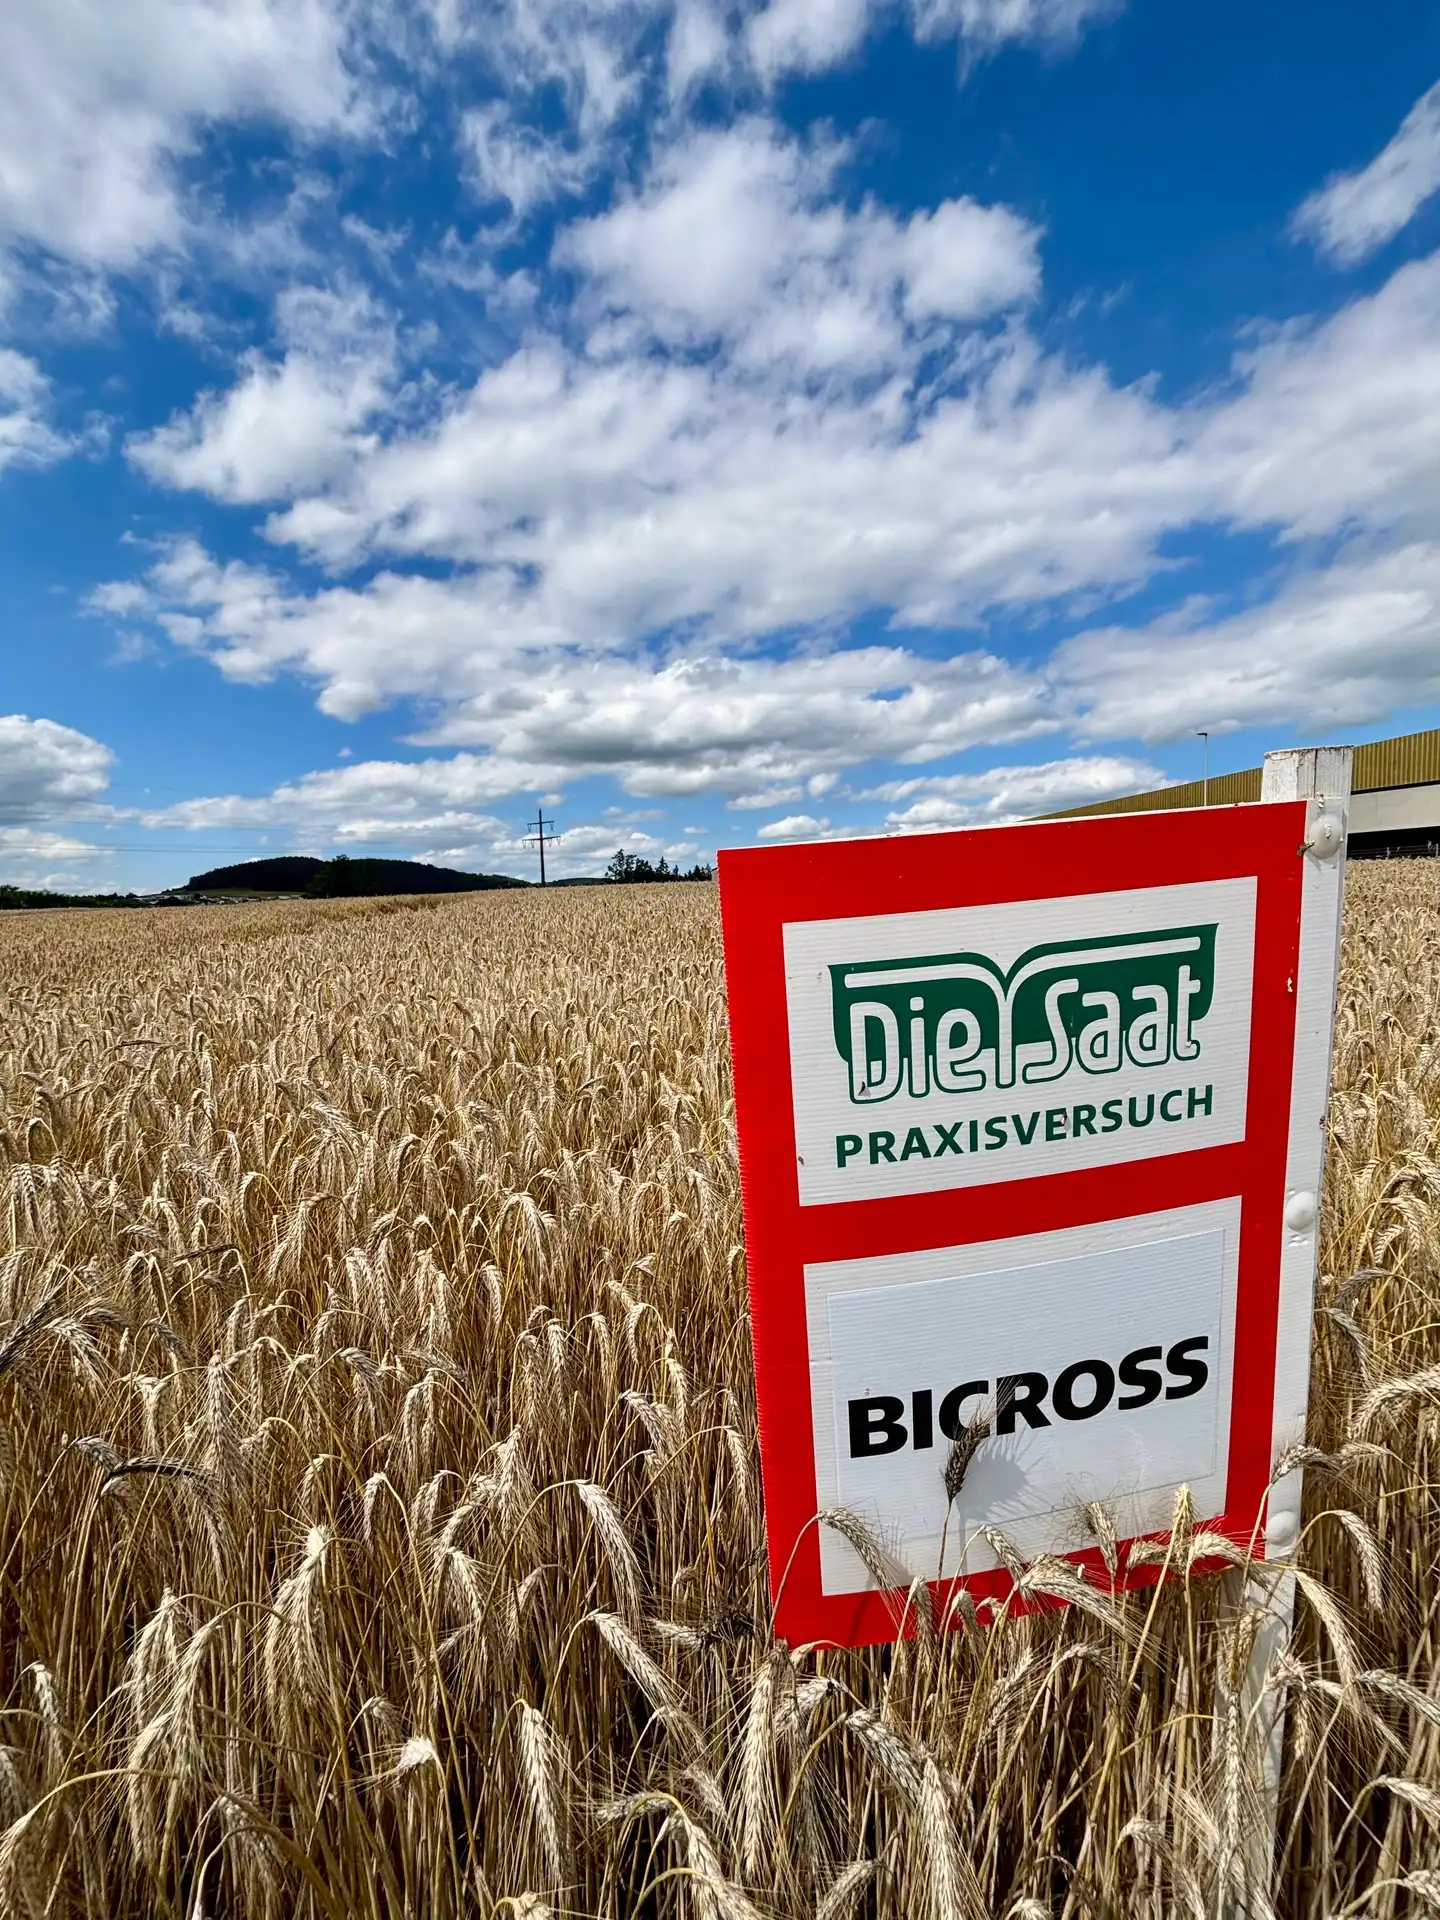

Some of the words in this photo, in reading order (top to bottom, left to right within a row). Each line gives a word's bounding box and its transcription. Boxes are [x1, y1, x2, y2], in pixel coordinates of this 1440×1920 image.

[848, 996, 988, 1104] Die
[1022, 964, 1202, 1084] Saat
[836, 1085, 1213, 1168] PRAXISVERSUCH
[848, 1336, 1209, 1458] BICROSS
